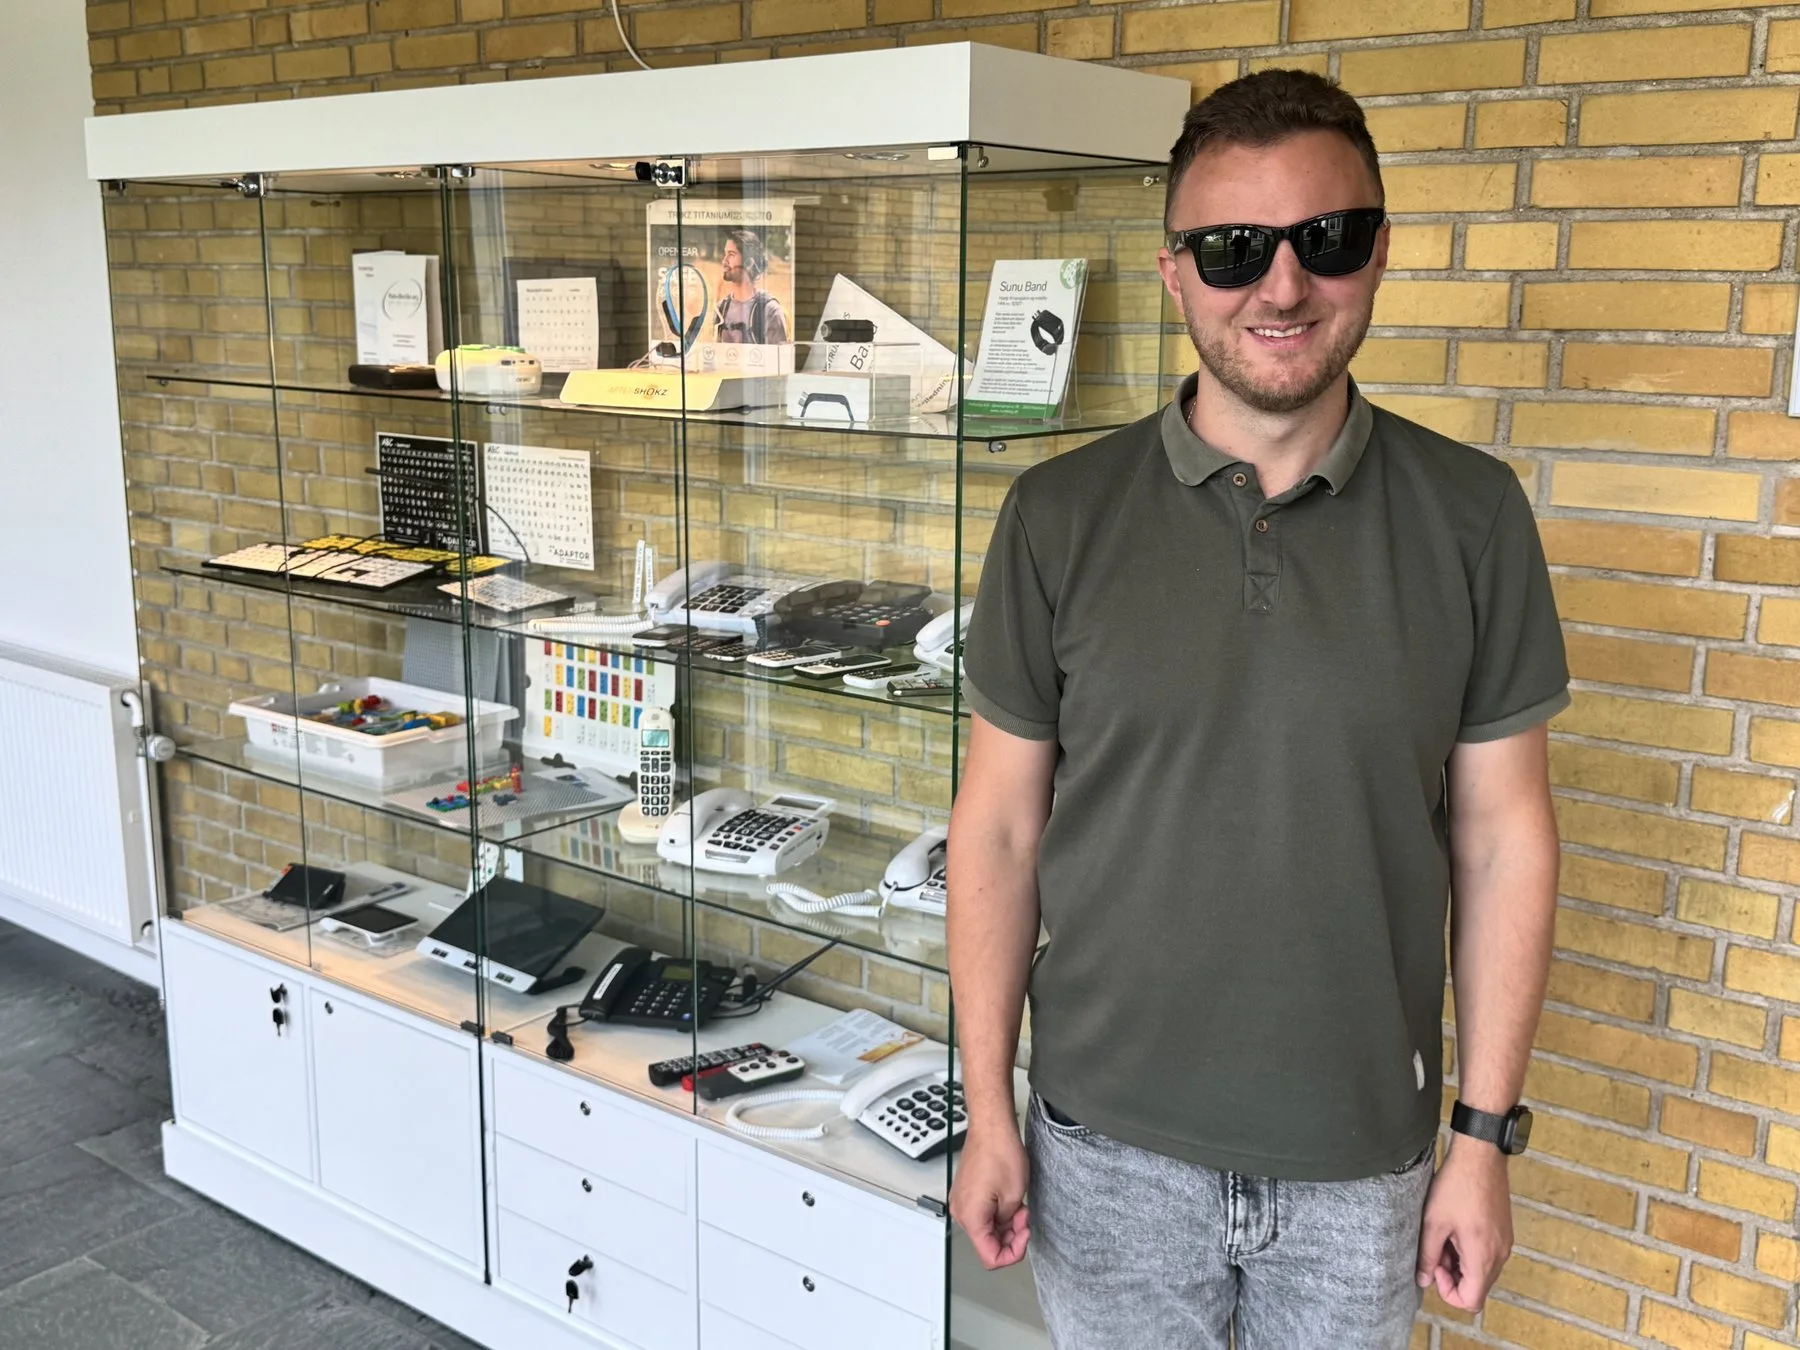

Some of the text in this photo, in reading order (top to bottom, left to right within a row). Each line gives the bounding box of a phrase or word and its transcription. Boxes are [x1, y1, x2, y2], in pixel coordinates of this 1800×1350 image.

[999, 281, 1048, 292] Sunu Band
[553, 549, 590, 560] ADAPTOR
